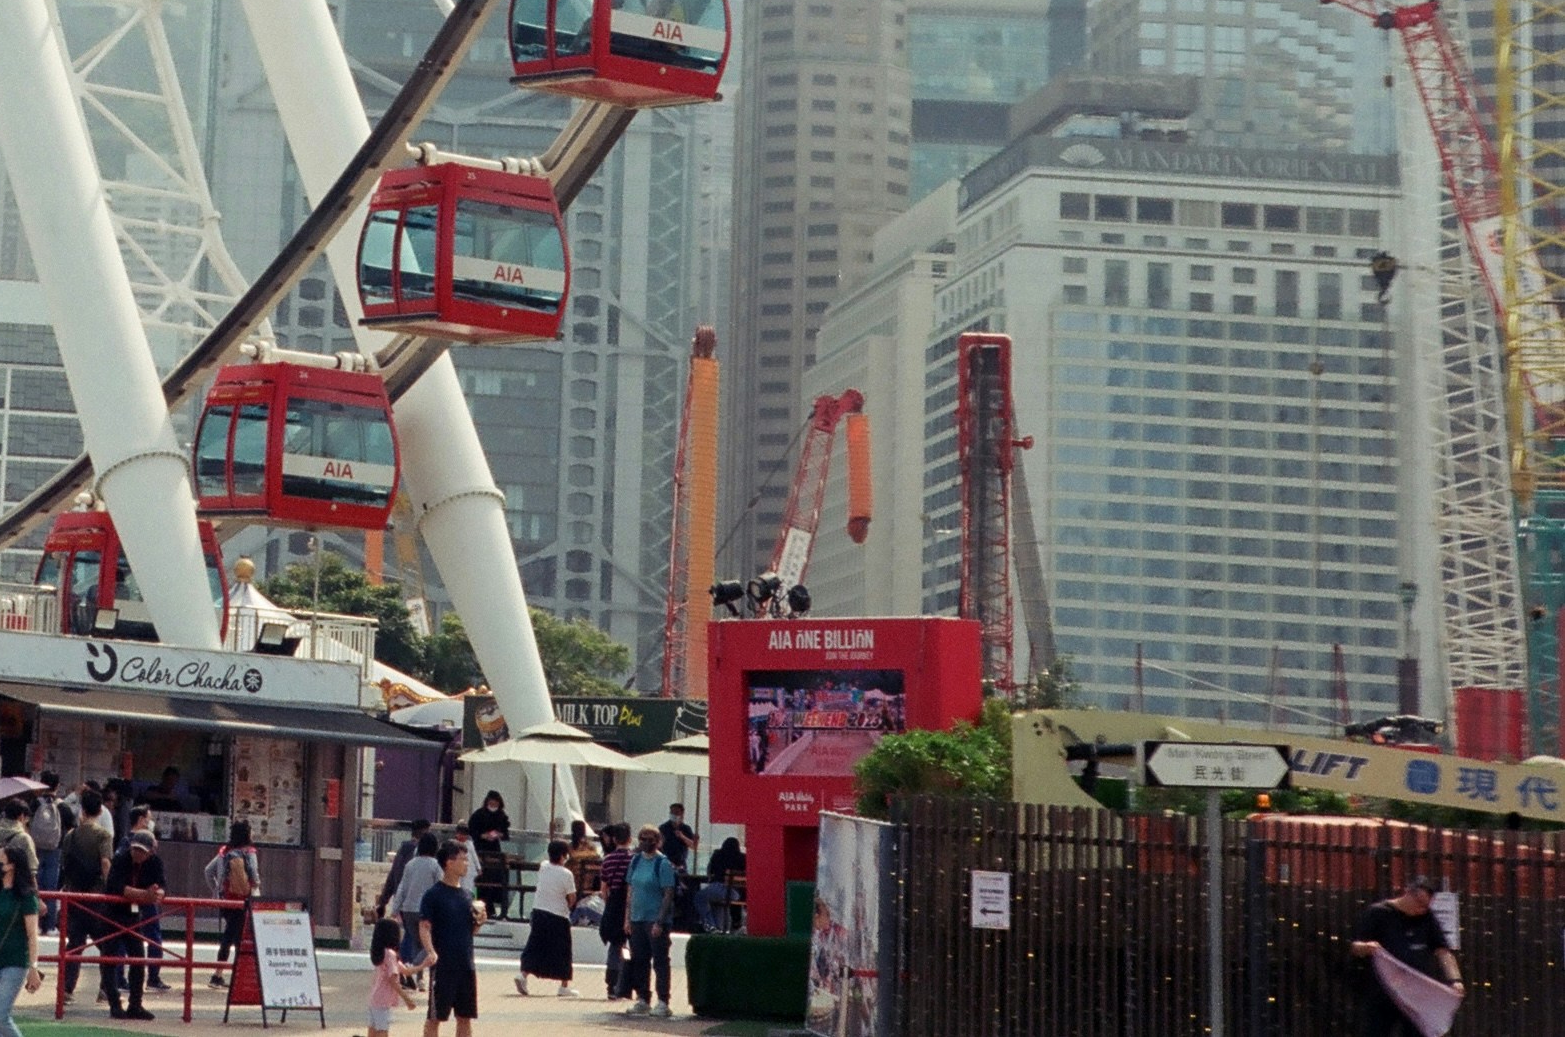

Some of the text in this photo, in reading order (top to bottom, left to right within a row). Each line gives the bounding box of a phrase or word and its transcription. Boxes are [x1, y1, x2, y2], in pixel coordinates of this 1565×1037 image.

[651, 20, 684, 42] AIA
[493, 263, 525, 285] AIA
[322, 460, 354, 480] AIA
[768, 630, 792, 649] AIA
[121, 656, 175, 685] Color
[176, 662, 242, 691] Chacha
[592, 704, 619, 726] TOP
[619, 705, 643, 727] Plus
[848, 711, 883, 728] 2023
[778, 792, 796, 802] AIA
[1456, 766, 1559, 811] 現代
[785, 803, 809, 812] PARK
